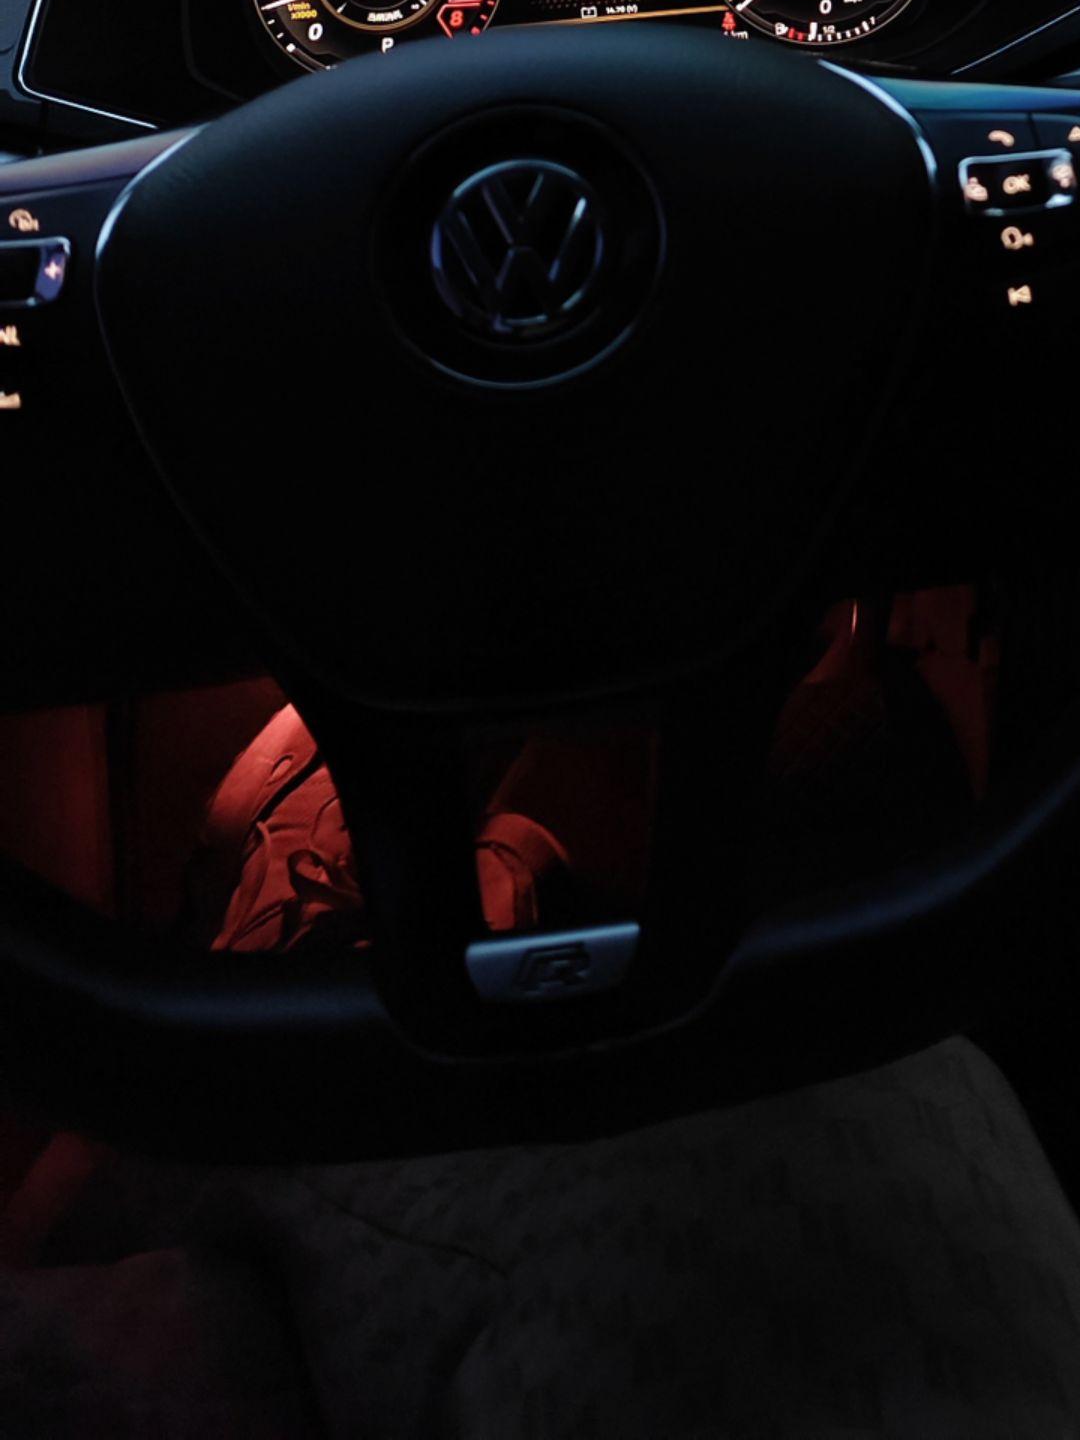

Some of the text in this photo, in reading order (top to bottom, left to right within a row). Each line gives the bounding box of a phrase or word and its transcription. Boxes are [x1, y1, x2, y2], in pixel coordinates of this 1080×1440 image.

[820, 0, 831, 14] 0
[450, 11, 463, 27] 8
[309, 23, 323, 41] 0
[382, 38, 393, 53] P
